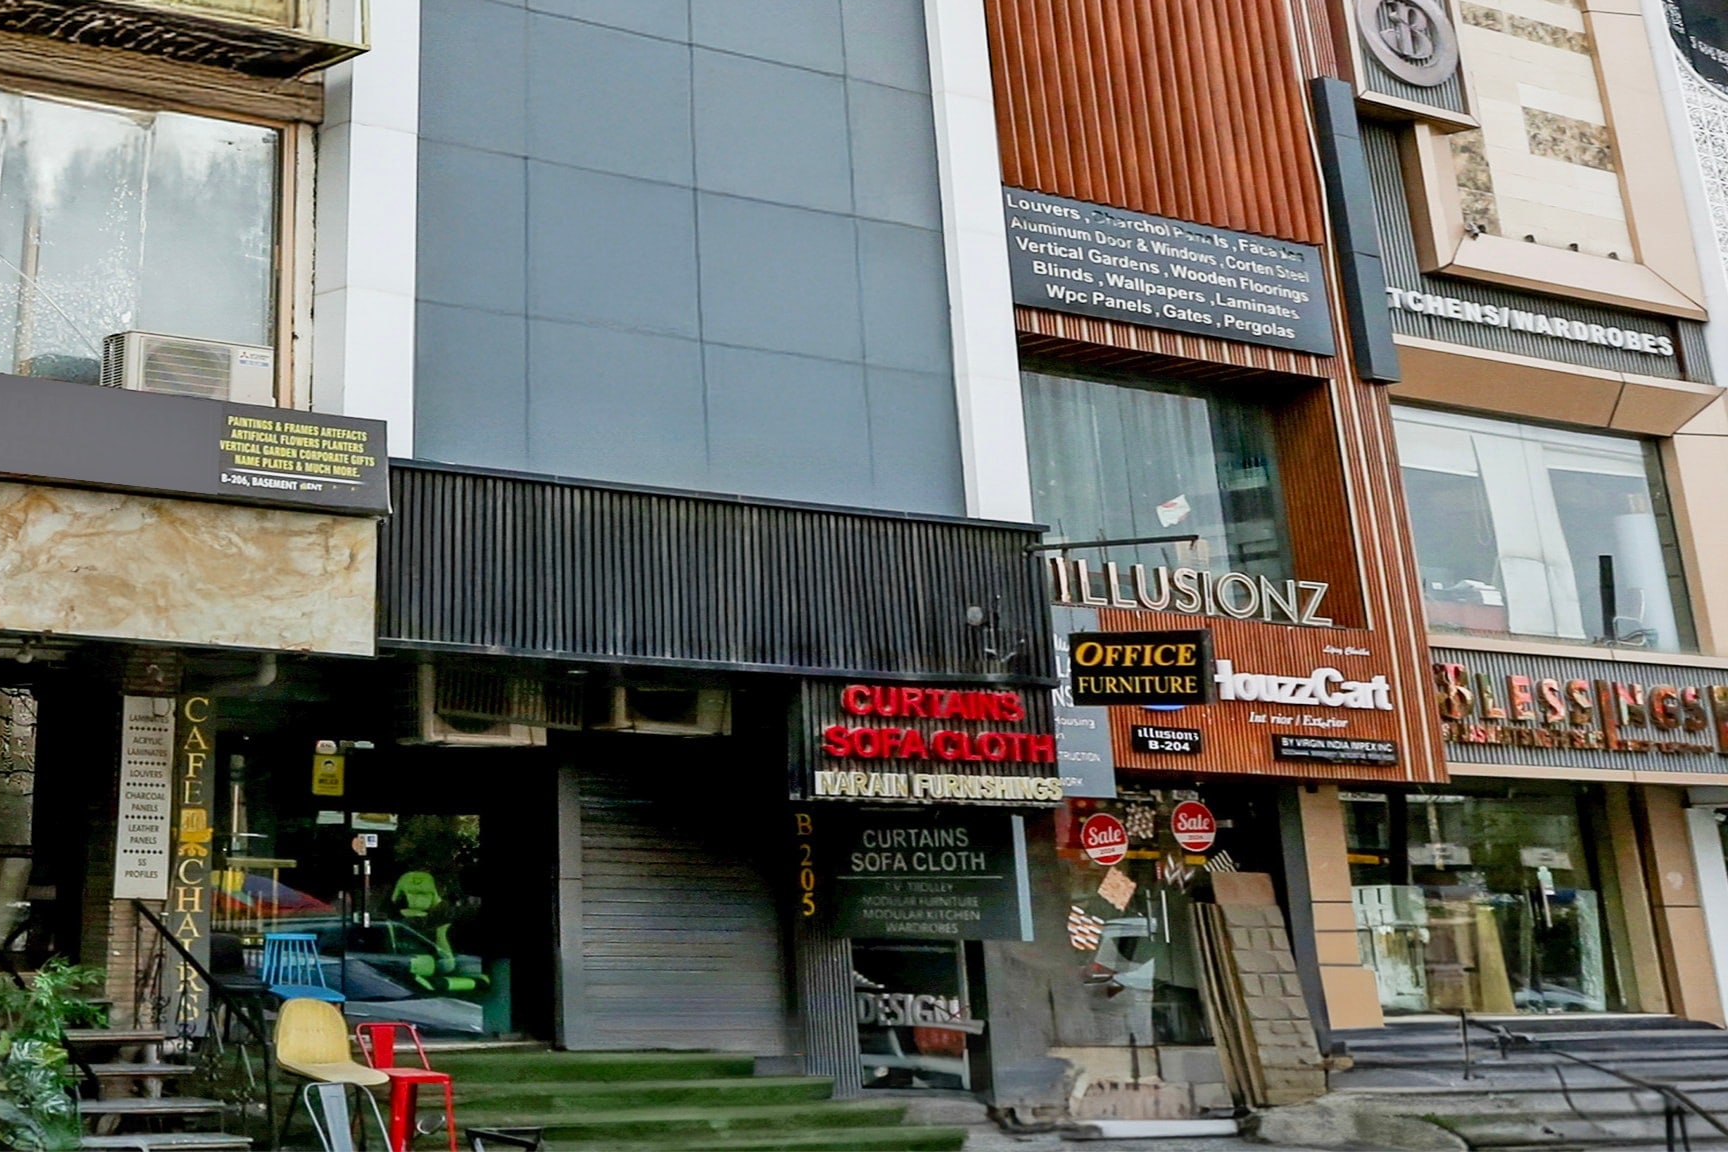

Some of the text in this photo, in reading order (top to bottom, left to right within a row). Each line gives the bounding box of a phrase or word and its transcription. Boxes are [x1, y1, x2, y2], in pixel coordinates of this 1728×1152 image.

[1007, 194, 1080, 220] Louvers
[1011, 216, 1310, 283] Aluminum Door & Windows Corten Steel
[1015, 236, 1309, 303] Vertical Gardens Wooden Floorings
[1032, 261, 1300, 320] Blinds Wallpapers Laminates
[1045, 284, 1296, 340] Wpc Panels Gates Pergolas
[1386, 286, 1674, 356] TCHENS/WARDROBES
[72, 332, 112, 350] Sunshine
[80, 323, 104, 337] Hotel
[228, 416, 368, 442] PAINTINGS & FRAMES ARTEFACTS
[231, 429, 364, 453] ARTIFICIAL FLOWERS PLANTERS
[220, 440, 375, 467] VERTICAL GARDEN CORPORATE GIFTS
[235, 454, 260, 468] NAME
[262, 458, 294, 471] PLATES
[296, 462, 302, 472] &
[305, 463, 331, 475] MUCH
[252, 477, 297, 490] BASEMENT
[1050, 557, 1333, 626] ILLUSIONZ
[1075, 642, 1197, 666] OFFICE
[1078, 676, 1198, 694] FURNITURE
[842, 684, 1025, 722] CURTAINS
[822, 724, 1055, 763] SOFA CLOTH
[1148, 740, 1191, 751] B-204
[815, 771, 1064, 800] NARAIN FURNISHINGS
[794, 813, 813, 836] B
[1177, 813, 1210, 831] Sale
[863, 828, 969, 848] CURTAINS
[1088, 826, 1122, 846] Sale
[851, 851, 986, 872] SOFA CLOTH
[862, 909, 980, 920] MODULAR KITCHEN
